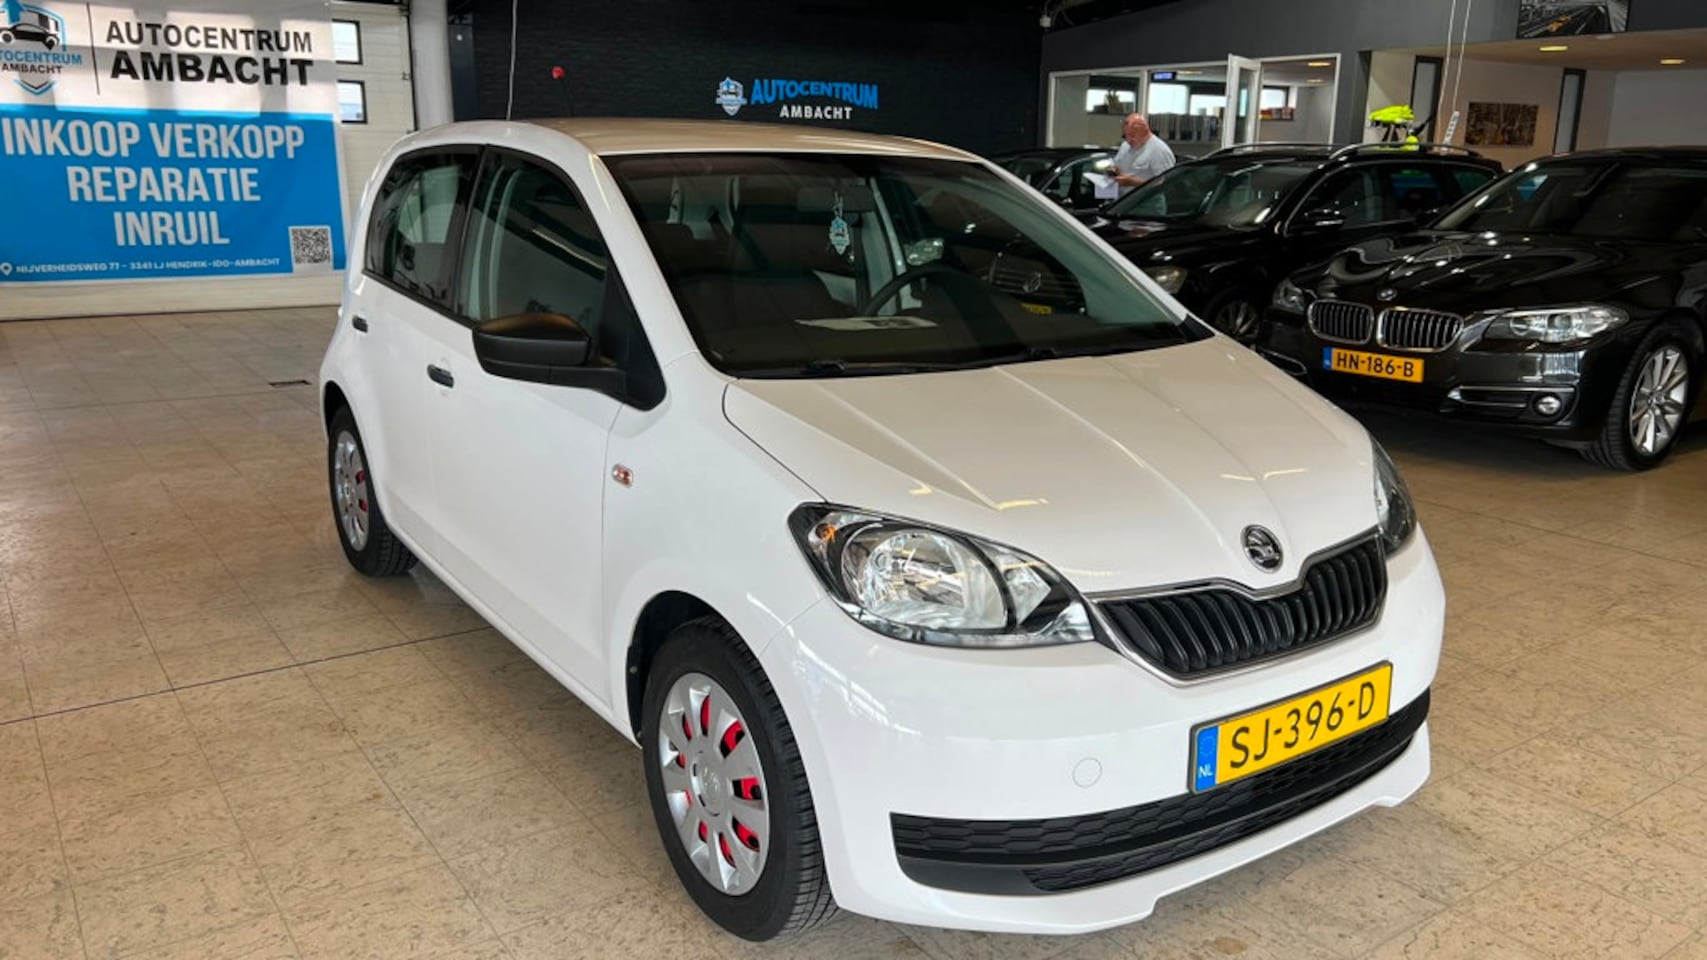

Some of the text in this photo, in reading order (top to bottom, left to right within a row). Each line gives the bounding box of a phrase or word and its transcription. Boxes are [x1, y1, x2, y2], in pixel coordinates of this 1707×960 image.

[106, 20, 313, 53] AUTOCENTRUM
[2, 62, 63, 74] AMBACHT
[110, 50, 314, 87] AMBACHT
[751, 78, 879, 110] AUTOCENTRUM
[779, 104, 853, 120] AMBACHT
[2, 117, 305, 160] INKOOP VERKOPP
[66, 165, 261, 203] REPARATIE
[113, 210, 231, 247] INRUIL
[16, 262, 107, 273] NIJVERHEIDSWEG
[1337, 352, 1414, 378] HN-186-B
[1230, 681, 1376, 770] SJ-396-D
[1198, 764, 1213, 778] NL
